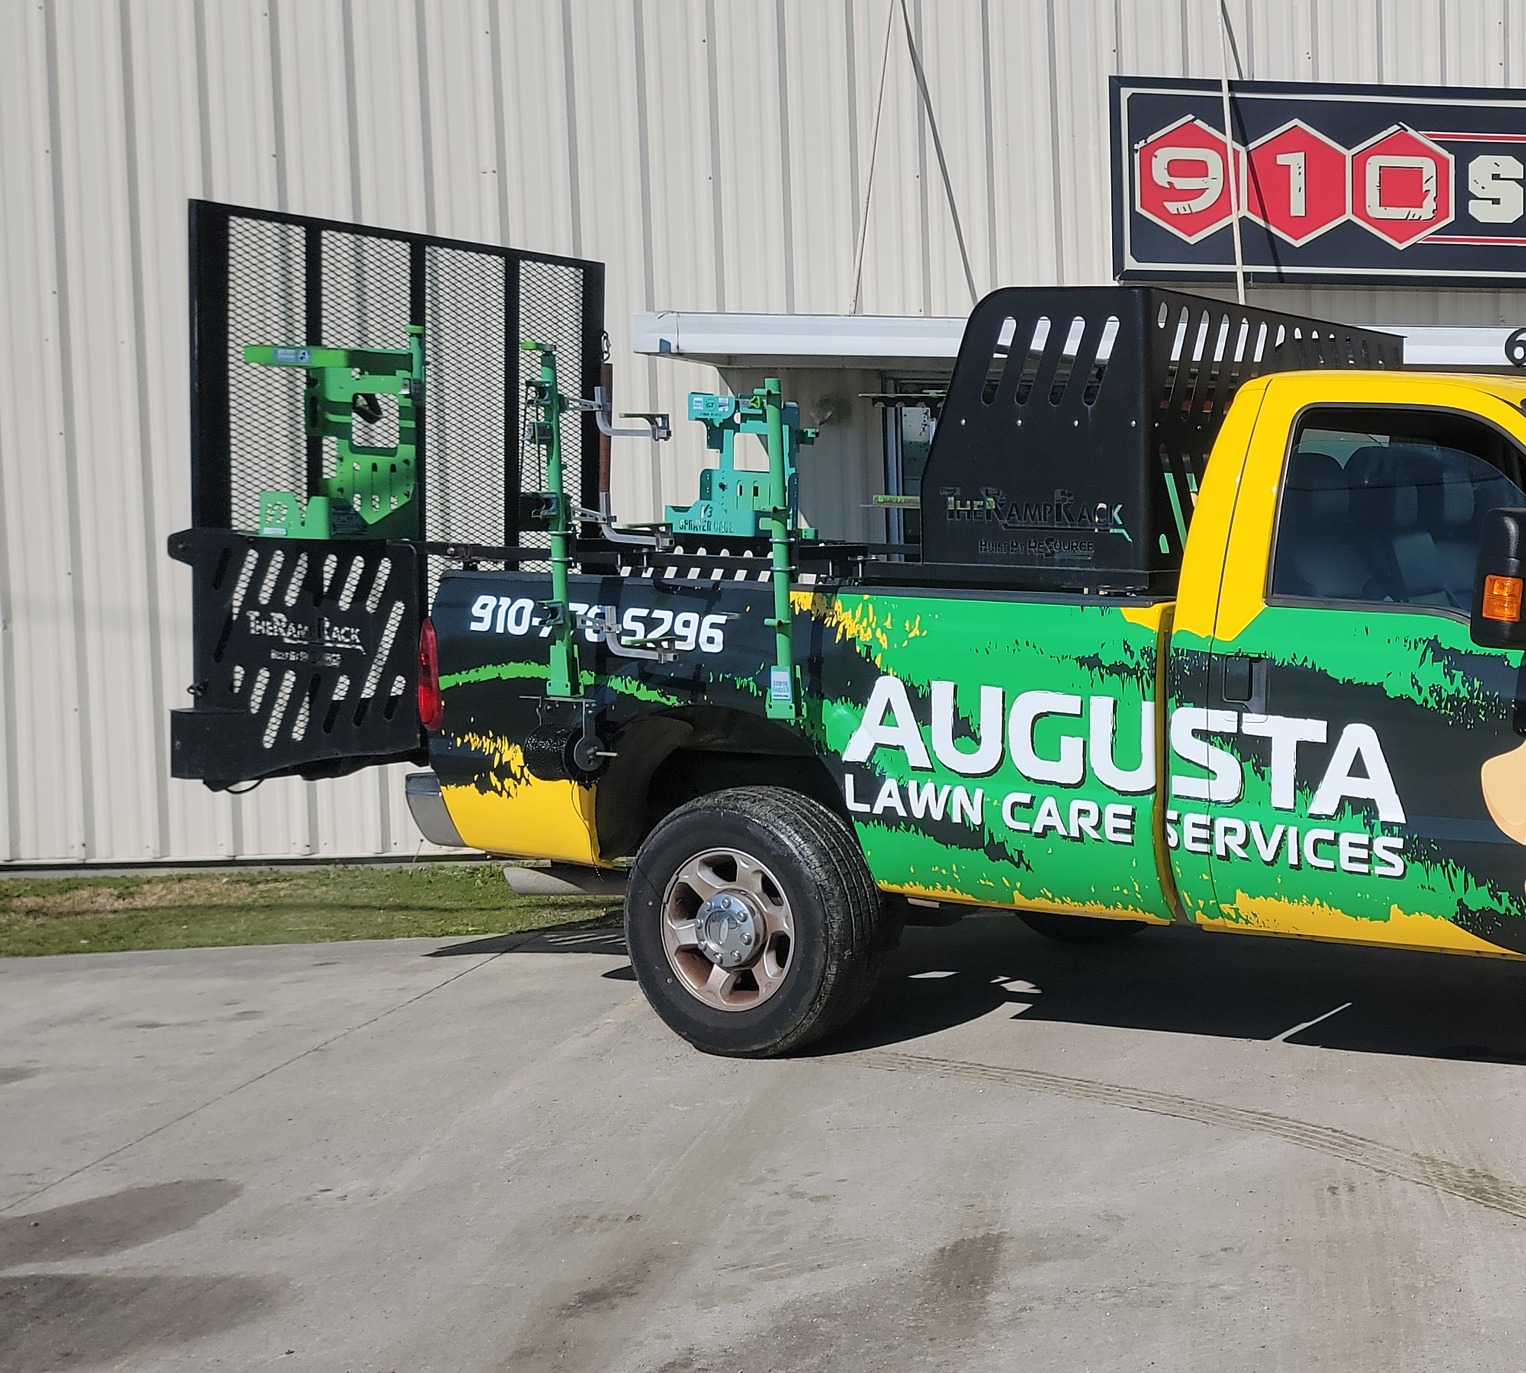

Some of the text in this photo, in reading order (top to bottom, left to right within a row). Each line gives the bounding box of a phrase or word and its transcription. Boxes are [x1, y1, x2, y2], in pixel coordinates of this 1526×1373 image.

[1152, 147, 1437, 220] 910
[841, 676, 1406, 824] AUGUSTA
[844, 774, 1406, 877] LAWN CARE SERVICES
